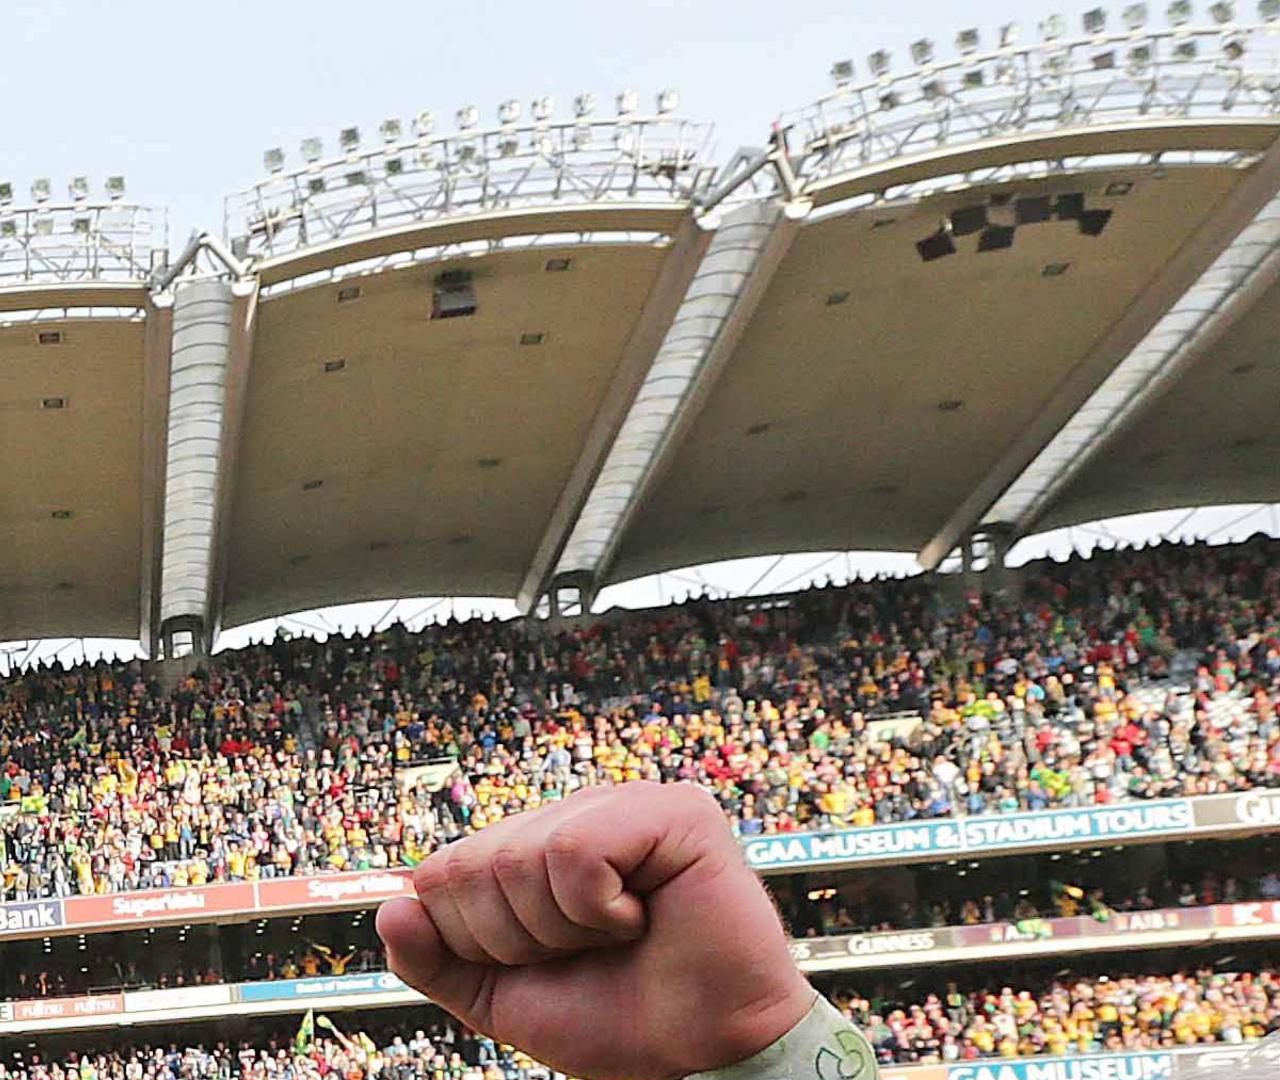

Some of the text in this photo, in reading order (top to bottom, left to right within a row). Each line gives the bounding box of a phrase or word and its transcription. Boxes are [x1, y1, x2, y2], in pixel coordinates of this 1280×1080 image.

[747, 802, 1189, 864] GAA MUSEUM & STADIUM TOURS
